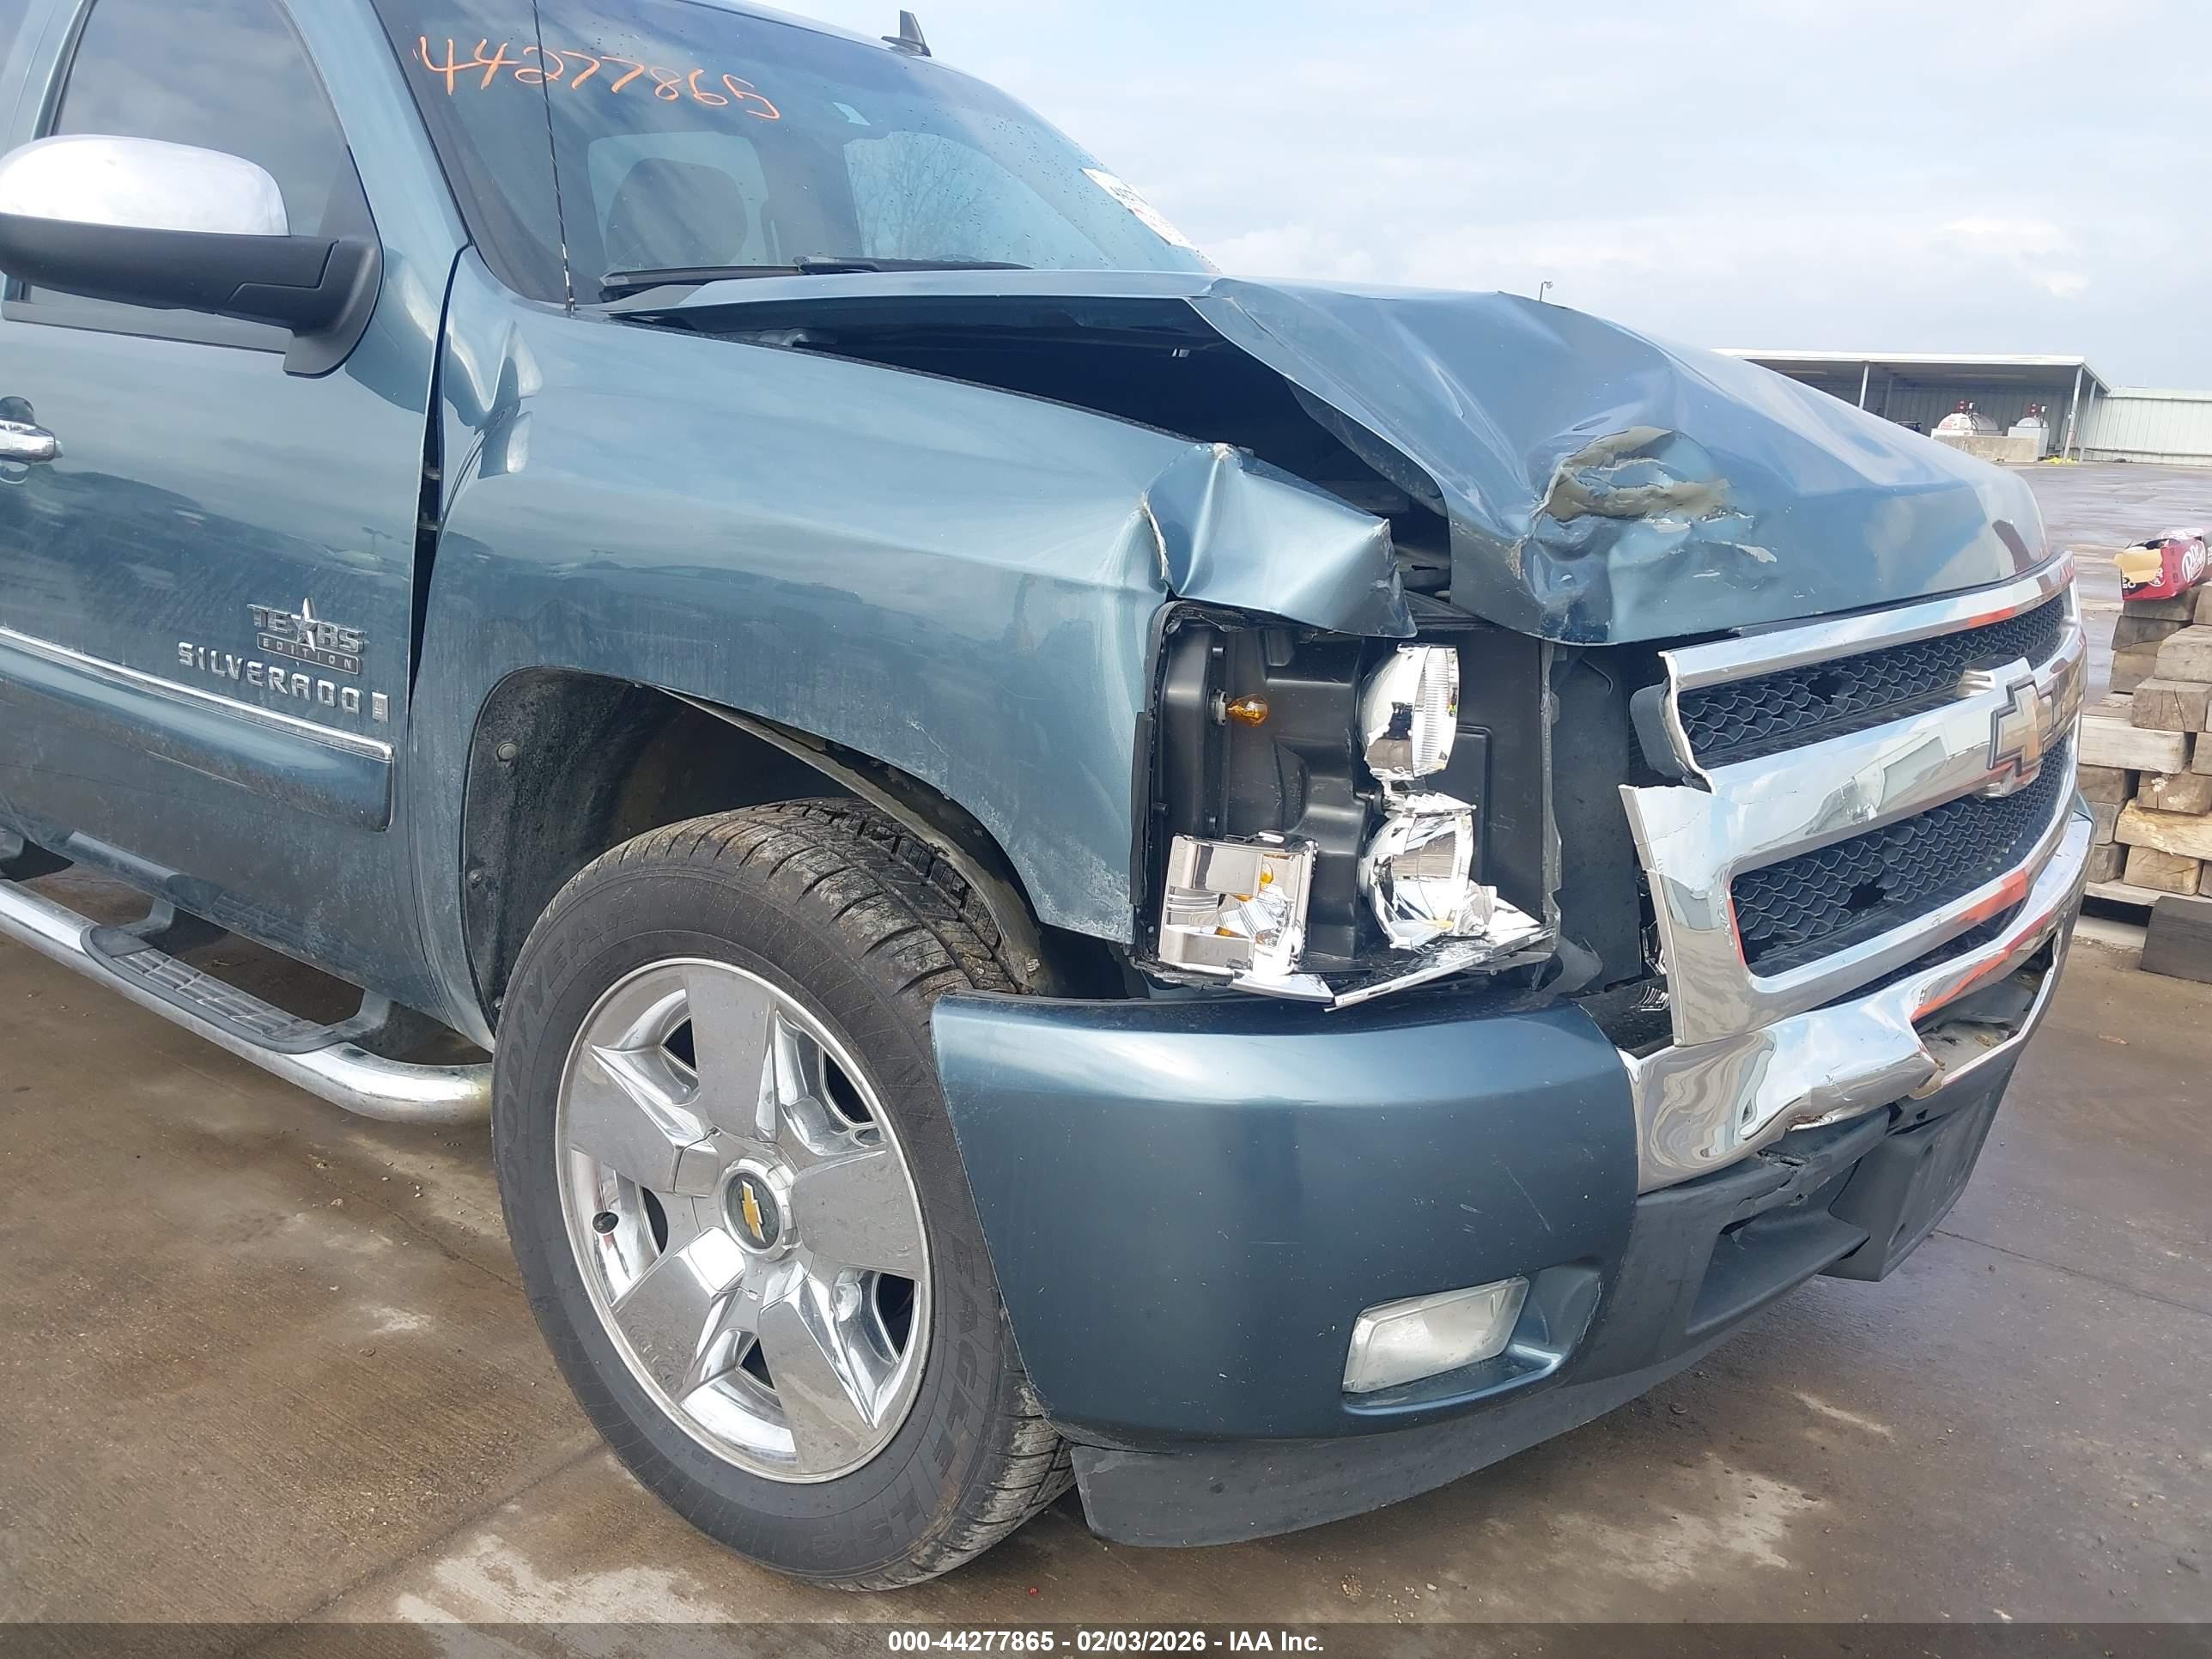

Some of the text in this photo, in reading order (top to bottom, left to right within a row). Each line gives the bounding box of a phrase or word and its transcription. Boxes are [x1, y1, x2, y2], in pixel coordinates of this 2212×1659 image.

[421, 36, 781, 119] 44277865
[178, 641, 362, 714] SILVERADO
[262, 637, 353, 671] EDITION
